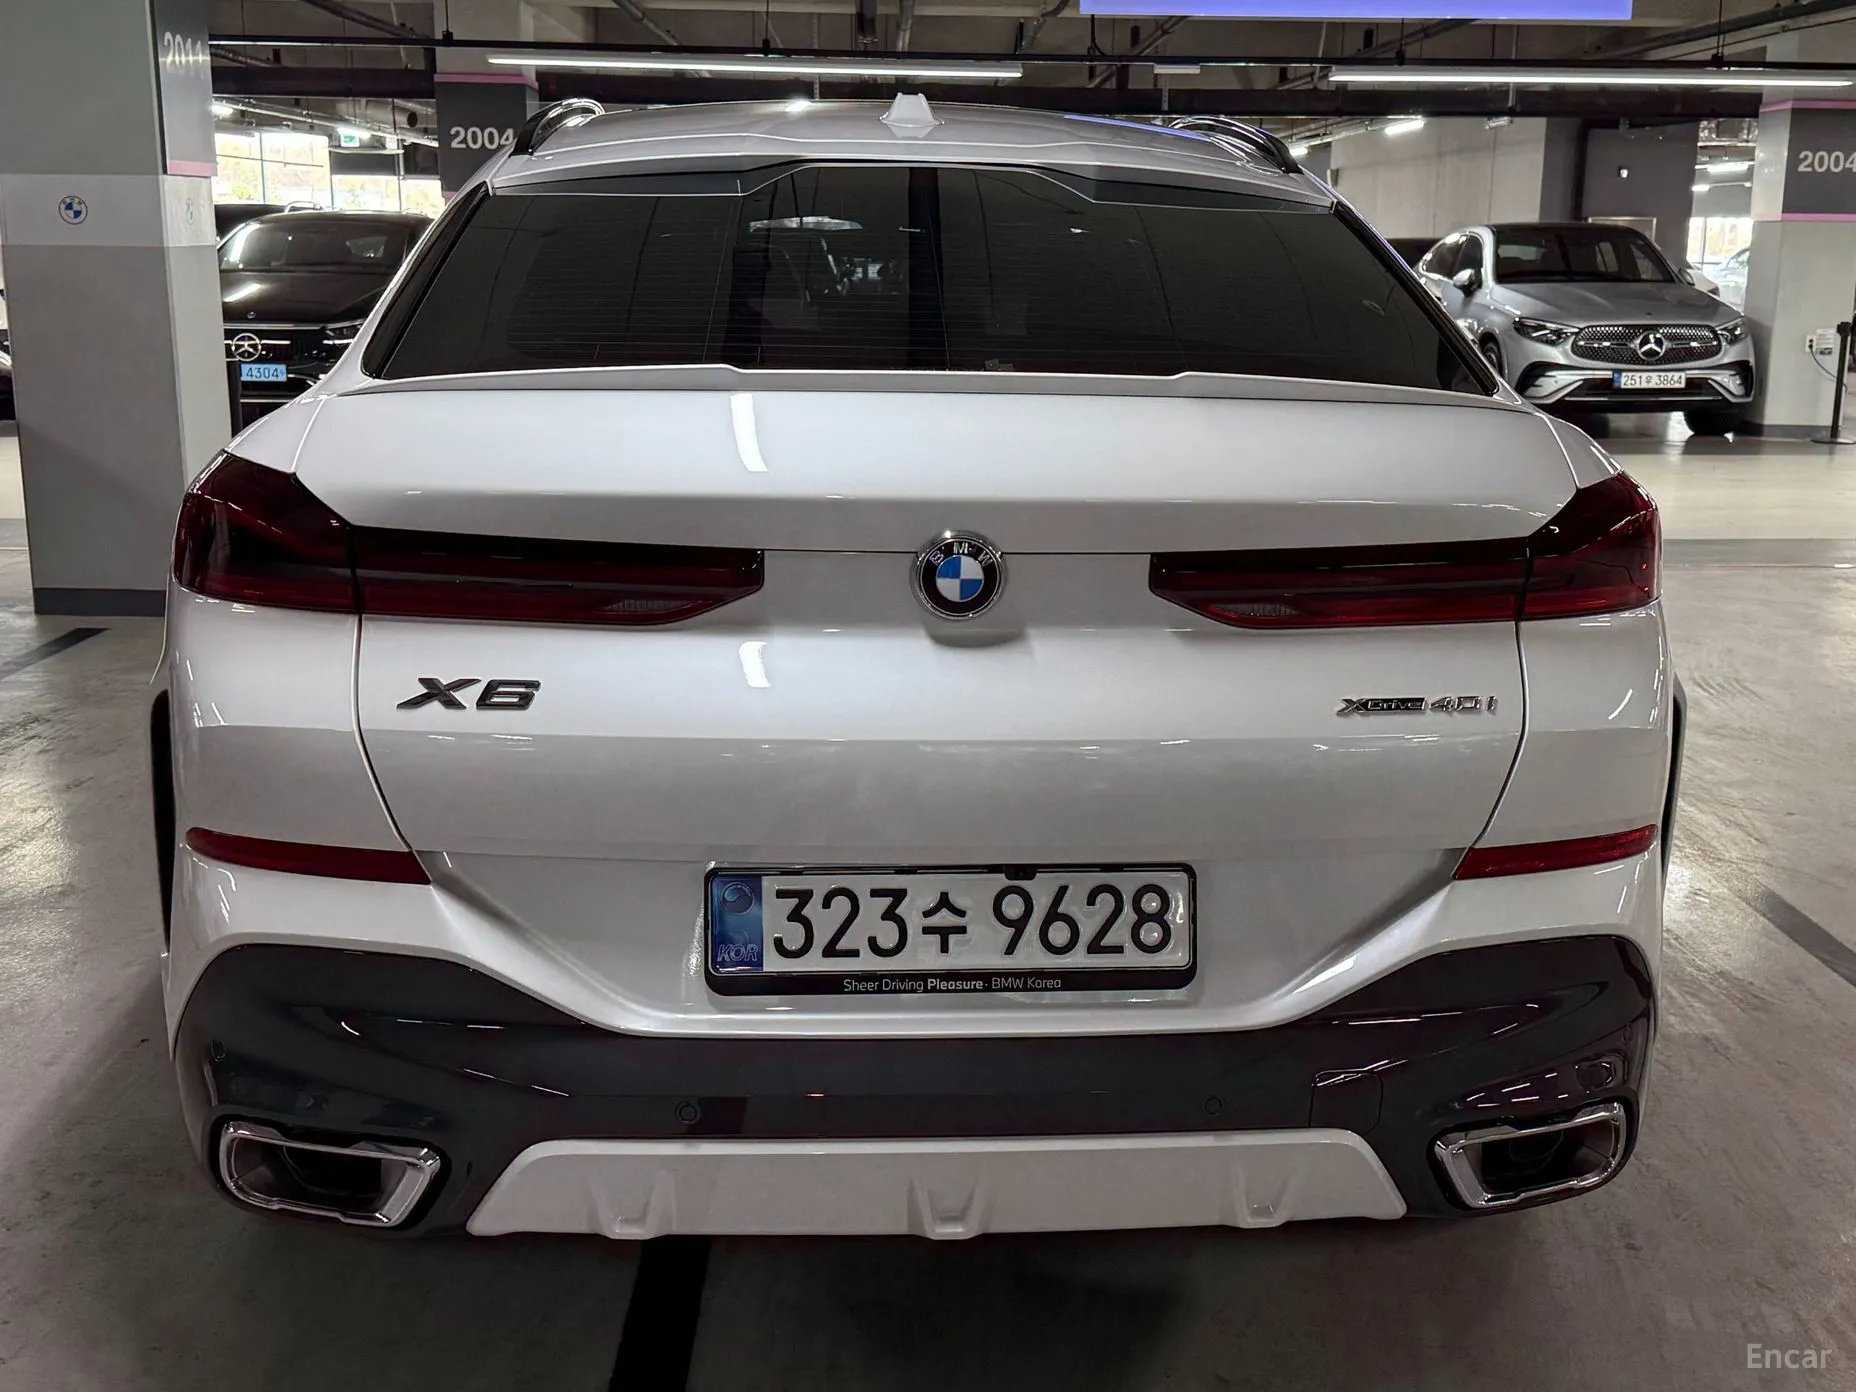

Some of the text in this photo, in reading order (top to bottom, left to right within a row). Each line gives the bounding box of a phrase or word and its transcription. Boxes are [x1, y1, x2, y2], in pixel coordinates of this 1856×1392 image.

[450, 126, 515, 149] 2004
[1797, 150, 1856, 173] 2004
[246, 367, 279, 379] 4304
[929, 542, 993, 566] BMW
[396, 677, 542, 710] X6
[992, 884, 1171, 956] 9628
[717, 943, 759, 961] KOR
[843, 979, 878, 992] Sheer
[882, 979, 924, 993] Driving
[992, 977, 1024, 990] BMW
[1027, 977, 1062, 989] Korea
